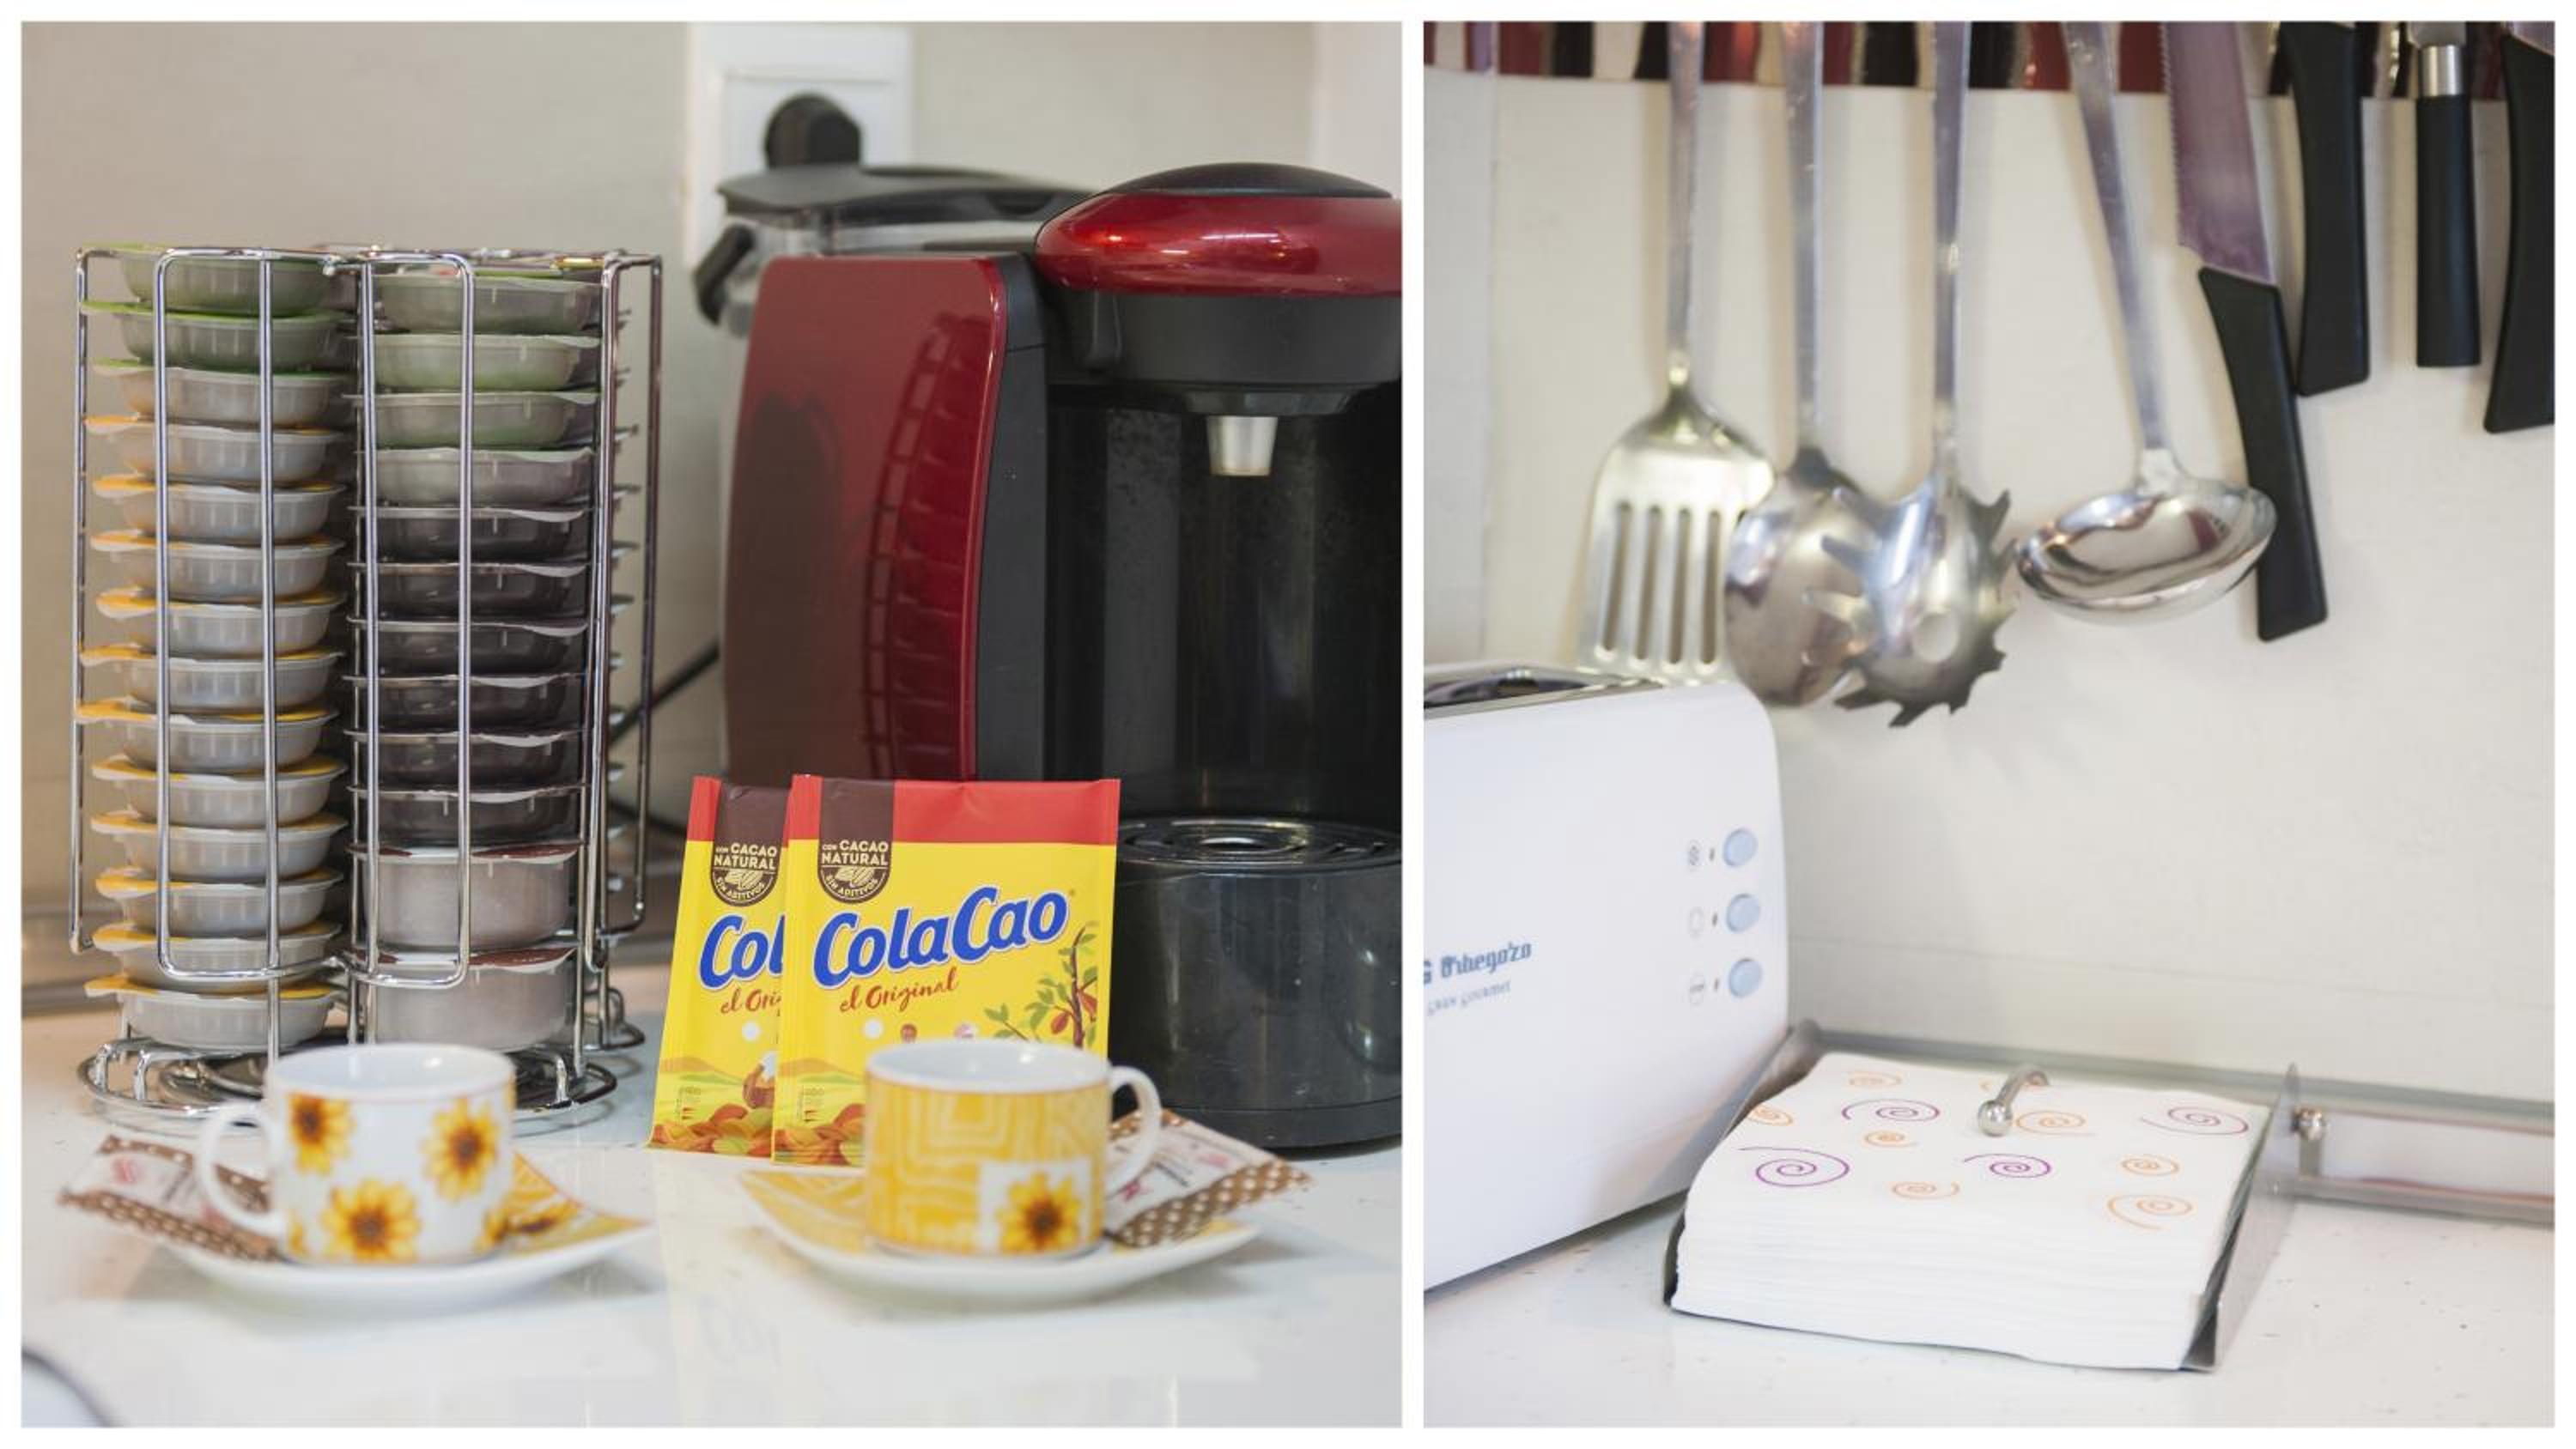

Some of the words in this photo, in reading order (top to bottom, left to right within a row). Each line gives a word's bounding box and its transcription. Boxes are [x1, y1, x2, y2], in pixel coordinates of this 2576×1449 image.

[731, 842, 778, 858] CACAO
[839, 840, 889, 853] CACAO
[714, 854, 776, 870] NATURAL
[822, 851, 889, 866] NATURAL
[840, 985, 860, 1013] el
[865, 966, 958, 1013] Original
[720, 987, 743, 1015] el
